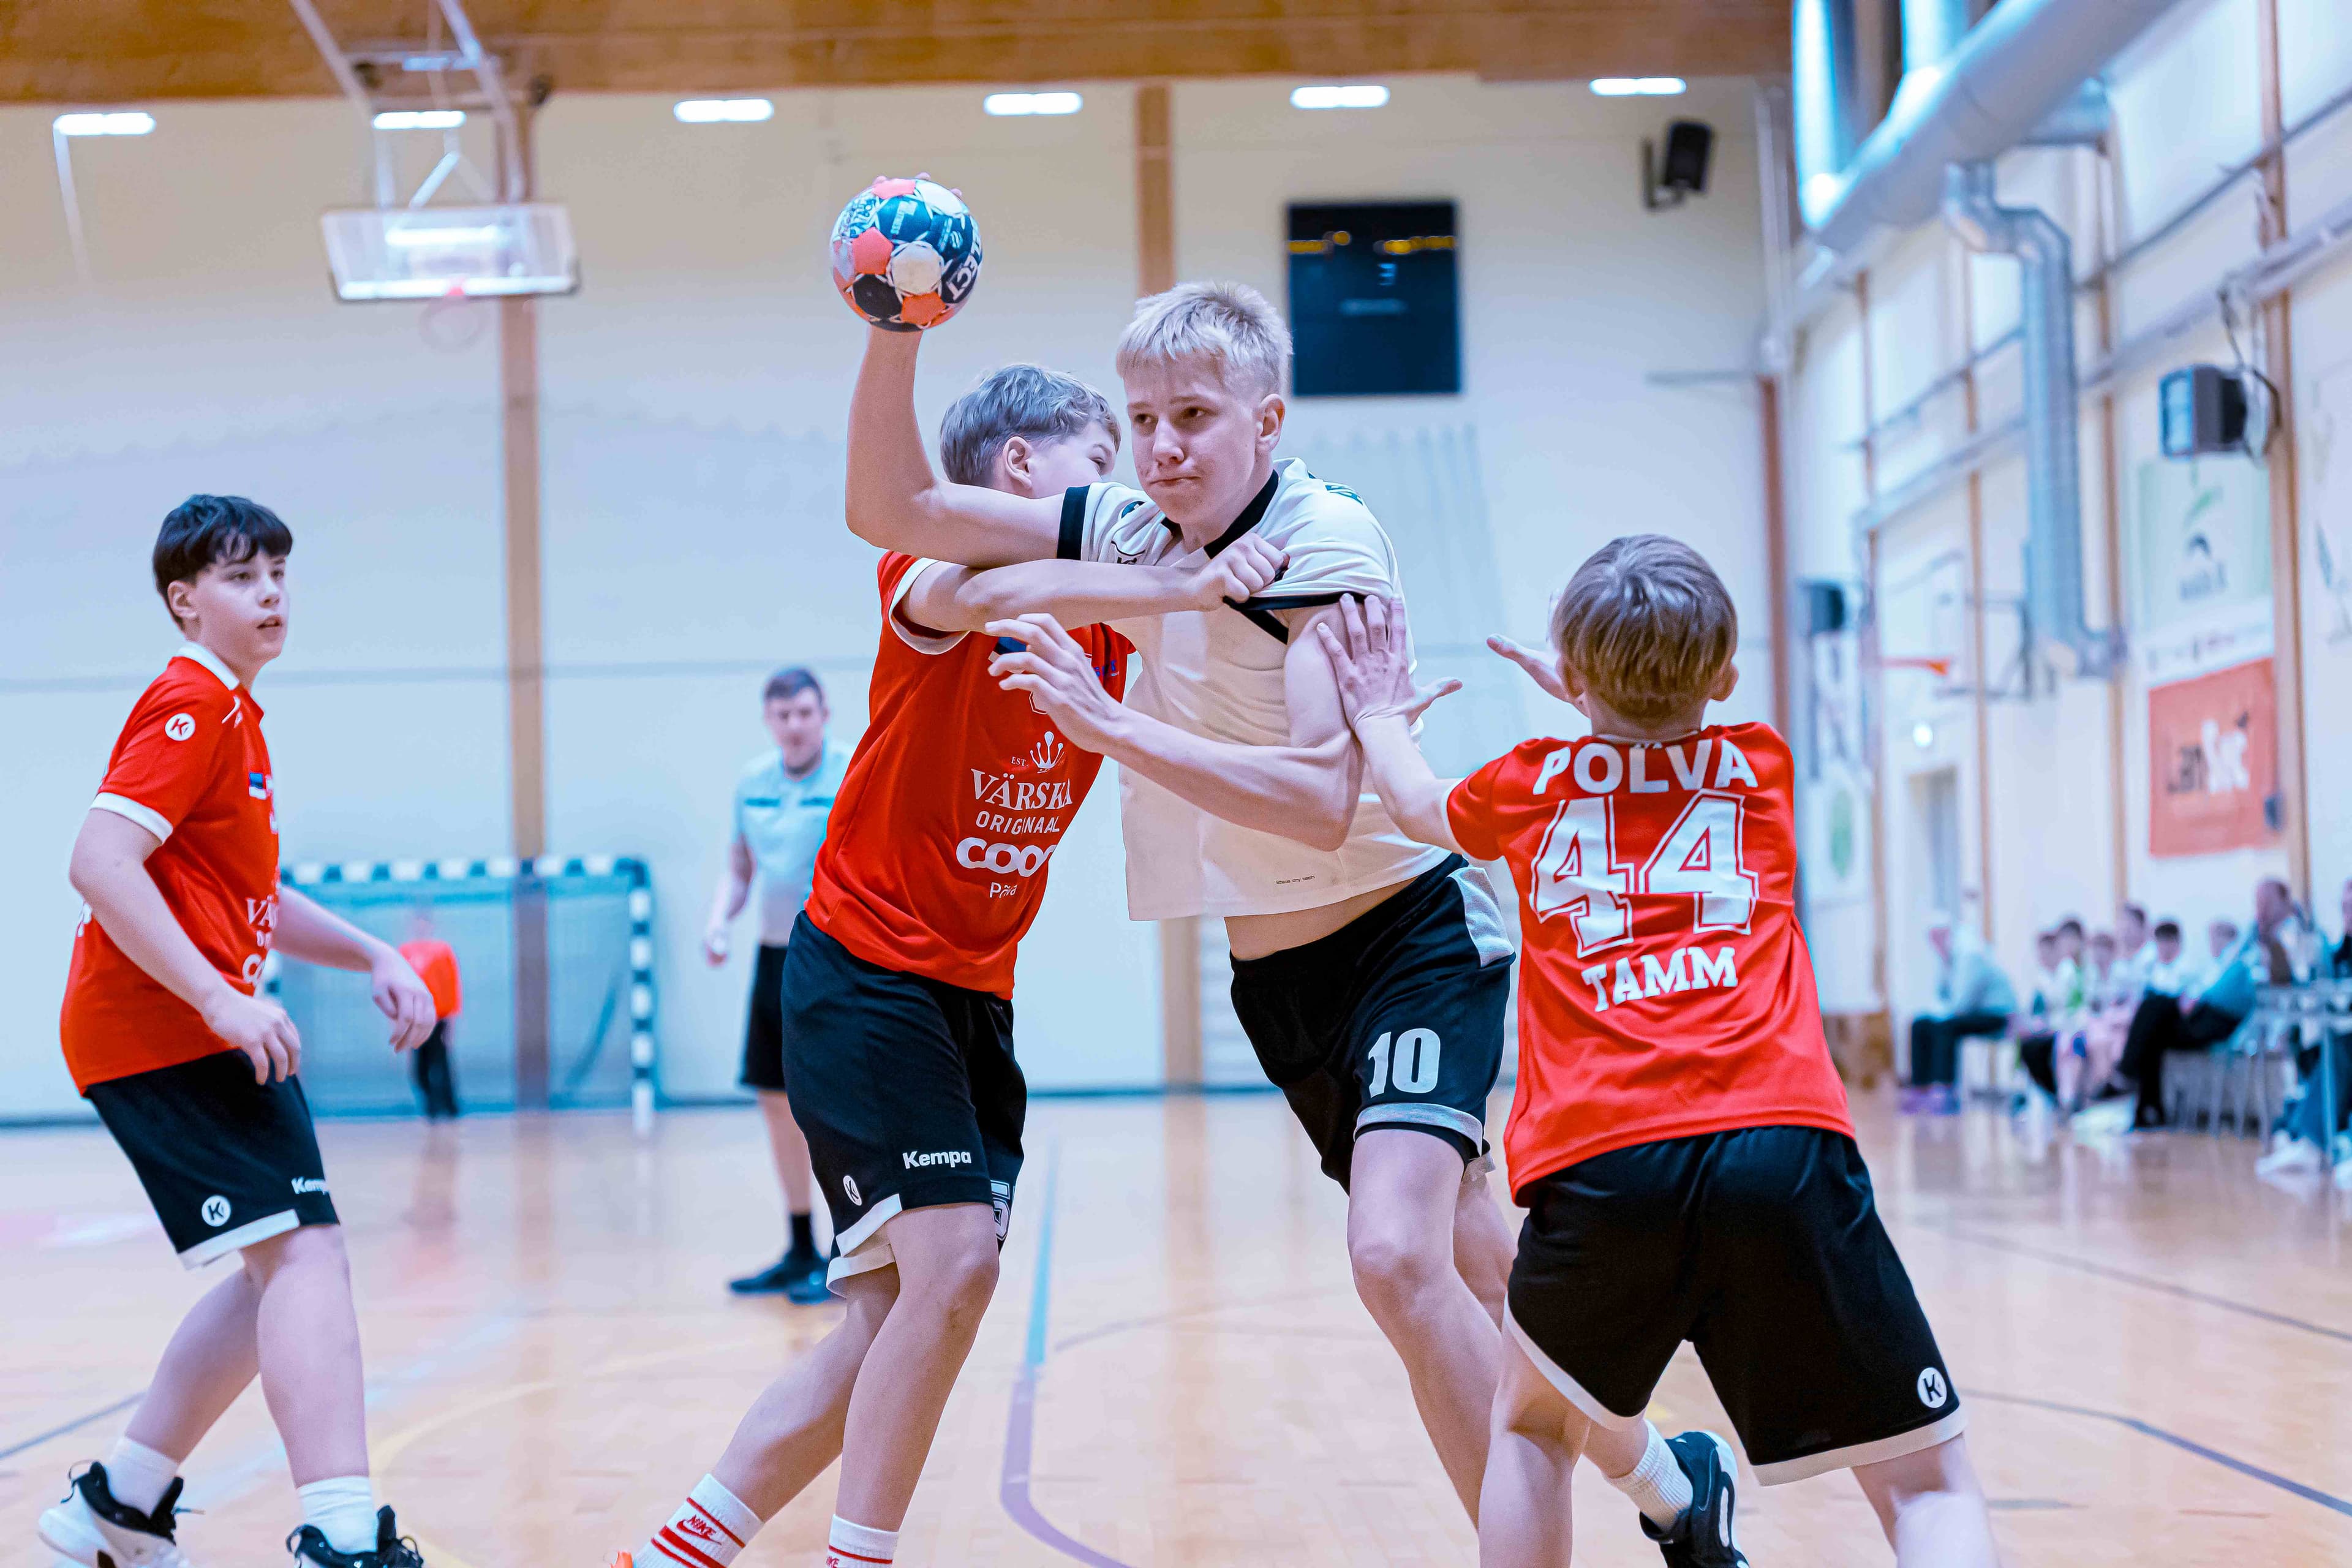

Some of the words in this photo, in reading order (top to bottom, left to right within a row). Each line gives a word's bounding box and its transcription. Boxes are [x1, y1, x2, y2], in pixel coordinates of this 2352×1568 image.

[1011, 756, 1029, 767] EST.
[976, 811, 1060, 835] ORIGINAAL
[1529, 788, 1759, 959] 44
[1581, 946, 1738, 1012] TAMM
[1368, 1028, 1441, 1098] 10
[902, 1151, 971, 1169] Kempa
